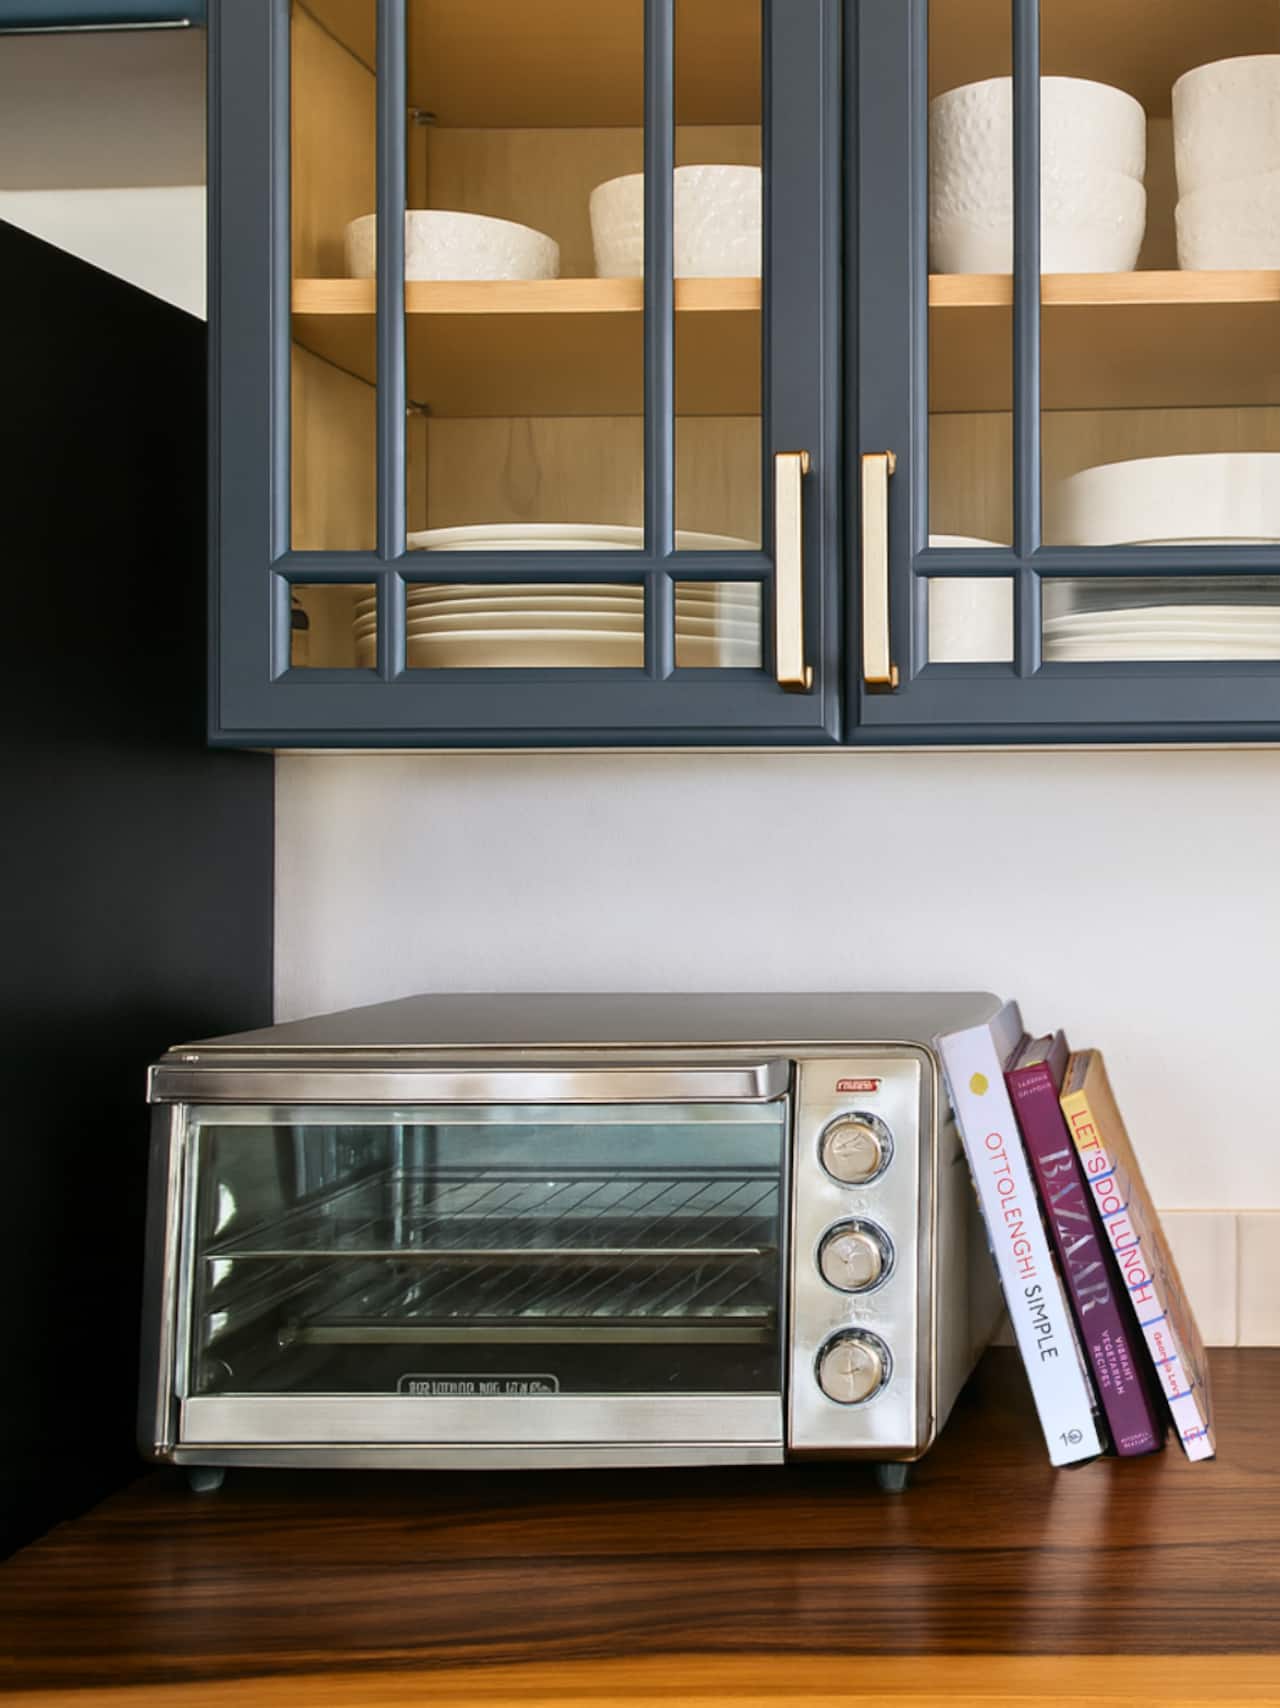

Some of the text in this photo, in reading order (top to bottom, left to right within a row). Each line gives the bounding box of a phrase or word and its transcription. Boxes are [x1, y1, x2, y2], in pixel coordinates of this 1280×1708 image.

[985, 1132, 1038, 1280] OTTOLENGHI
[1024, 1283, 1059, 1362] SIMPLE
[1039, 1148, 1111, 1316] BAZAAR
[1071, 1110, 1153, 1304] LET'S DO LUNCH
[1094, 1345, 1111, 1388] RECIPES
[1102, 1329, 1125, 1395] VEGETARIAN
[1115, 1336, 1133, 1380] VIBRANT
